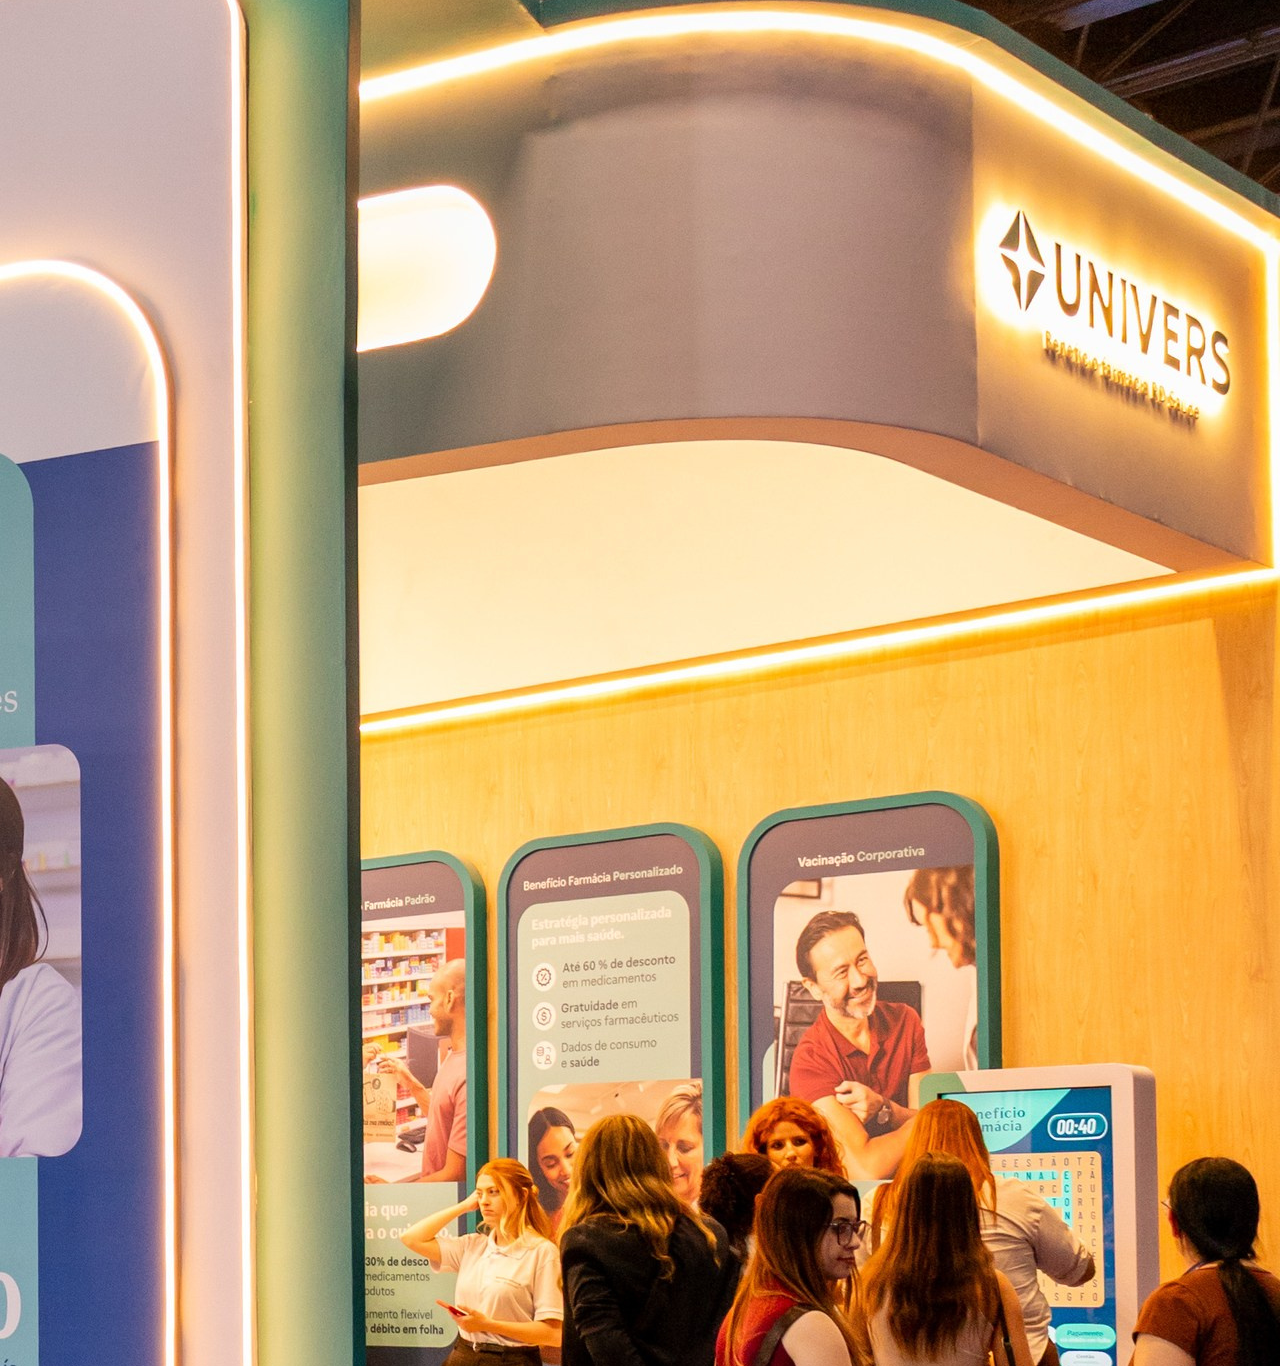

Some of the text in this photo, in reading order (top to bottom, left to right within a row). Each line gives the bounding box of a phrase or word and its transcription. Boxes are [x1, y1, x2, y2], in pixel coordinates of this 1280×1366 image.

[1055, 242, 1231, 396] UNIVERS
[797, 845, 925, 867] Vacinação Corporativa
[523, 864, 684, 892] Benefício Farmácia Personalizado
[364, 893, 436, 911] Farmácia Padrão
[531, 906, 672, 931] Estratégia personalizada
[531, 928, 625, 950] para mais saúde.
[562, 961, 581, 973] Até
[583, 960, 596, 971] 60
[610, 958, 623, 969] de
[626, 955, 676, 968] desconto
[562, 972, 657, 988] em medicamentos
[561, 999, 638, 1014] Gratuidade em
[561, 1012, 679, 1030] serviços farmacêuticos
[561, 1039, 657, 1053] Dados de consumo
[561, 1056, 600, 1068] e saúde
[976, 1106, 1026, 1120] nefício
[982, 1121, 1022, 1133] mácia
[1056, 1118, 1097, 1136] 00:40
[381, 1204, 408, 1221] que
[377, 1228, 387, 1240] o
[365, 1256, 429, 1267] 30% de desco
[365, 1286, 395, 1296] odutos
[401, 1309, 433, 1319] flexível
[370, 1324, 444, 1335] débito em folha
